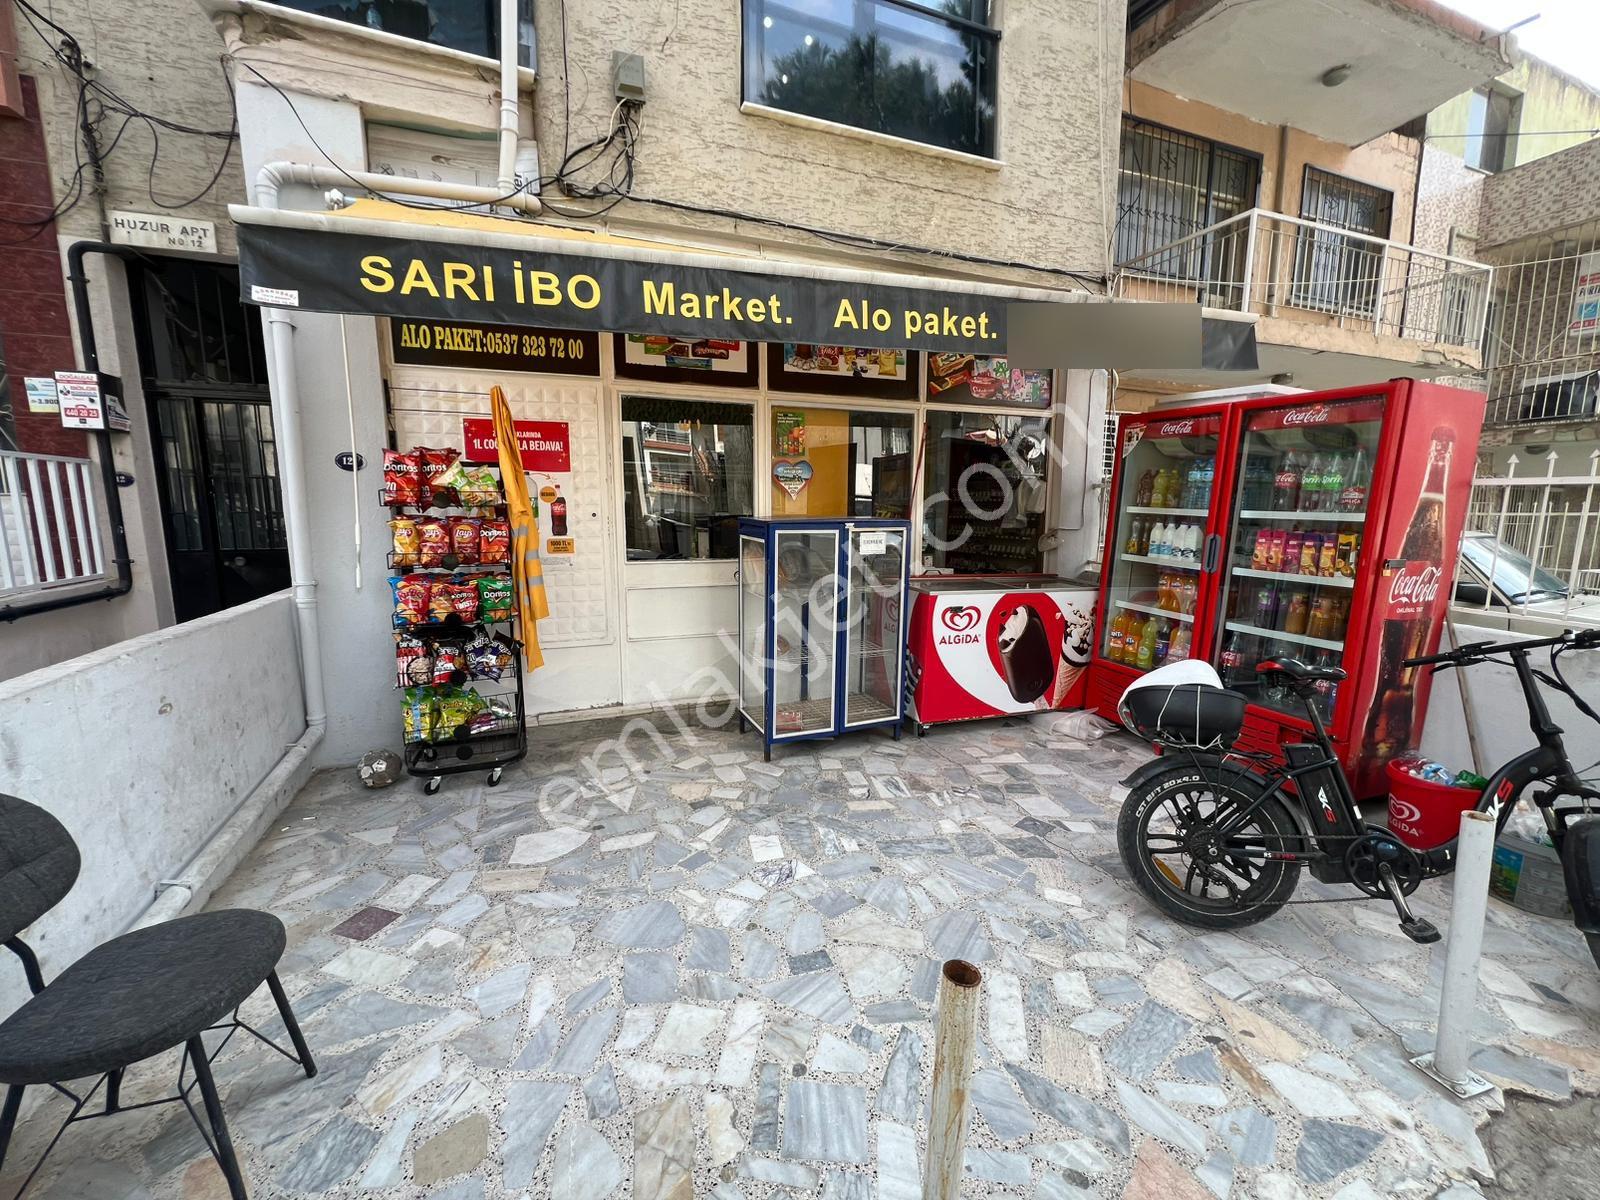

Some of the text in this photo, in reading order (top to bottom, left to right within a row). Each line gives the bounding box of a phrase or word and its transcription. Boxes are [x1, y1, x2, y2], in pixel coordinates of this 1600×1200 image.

[114, 217, 171, 234] HUZUR
[359, 254, 601, 310] SARI İBO
[642, 280, 793, 325] Market.
[833, 299, 998, 340] Alo paket.
[400, 323, 431, 349] ALO
[522, 335, 546, 357] 323
[550, 337, 565, 358] 72
[568, 339, 584, 360] 00
[65, 409, 98, 418] 440 20 25
[473, 439, 483, 449] 1L
[529, 440, 564, 452] BEDAVA!
[384, 463, 418, 473] Doritos
[483, 590, 511, 599] Doritos
